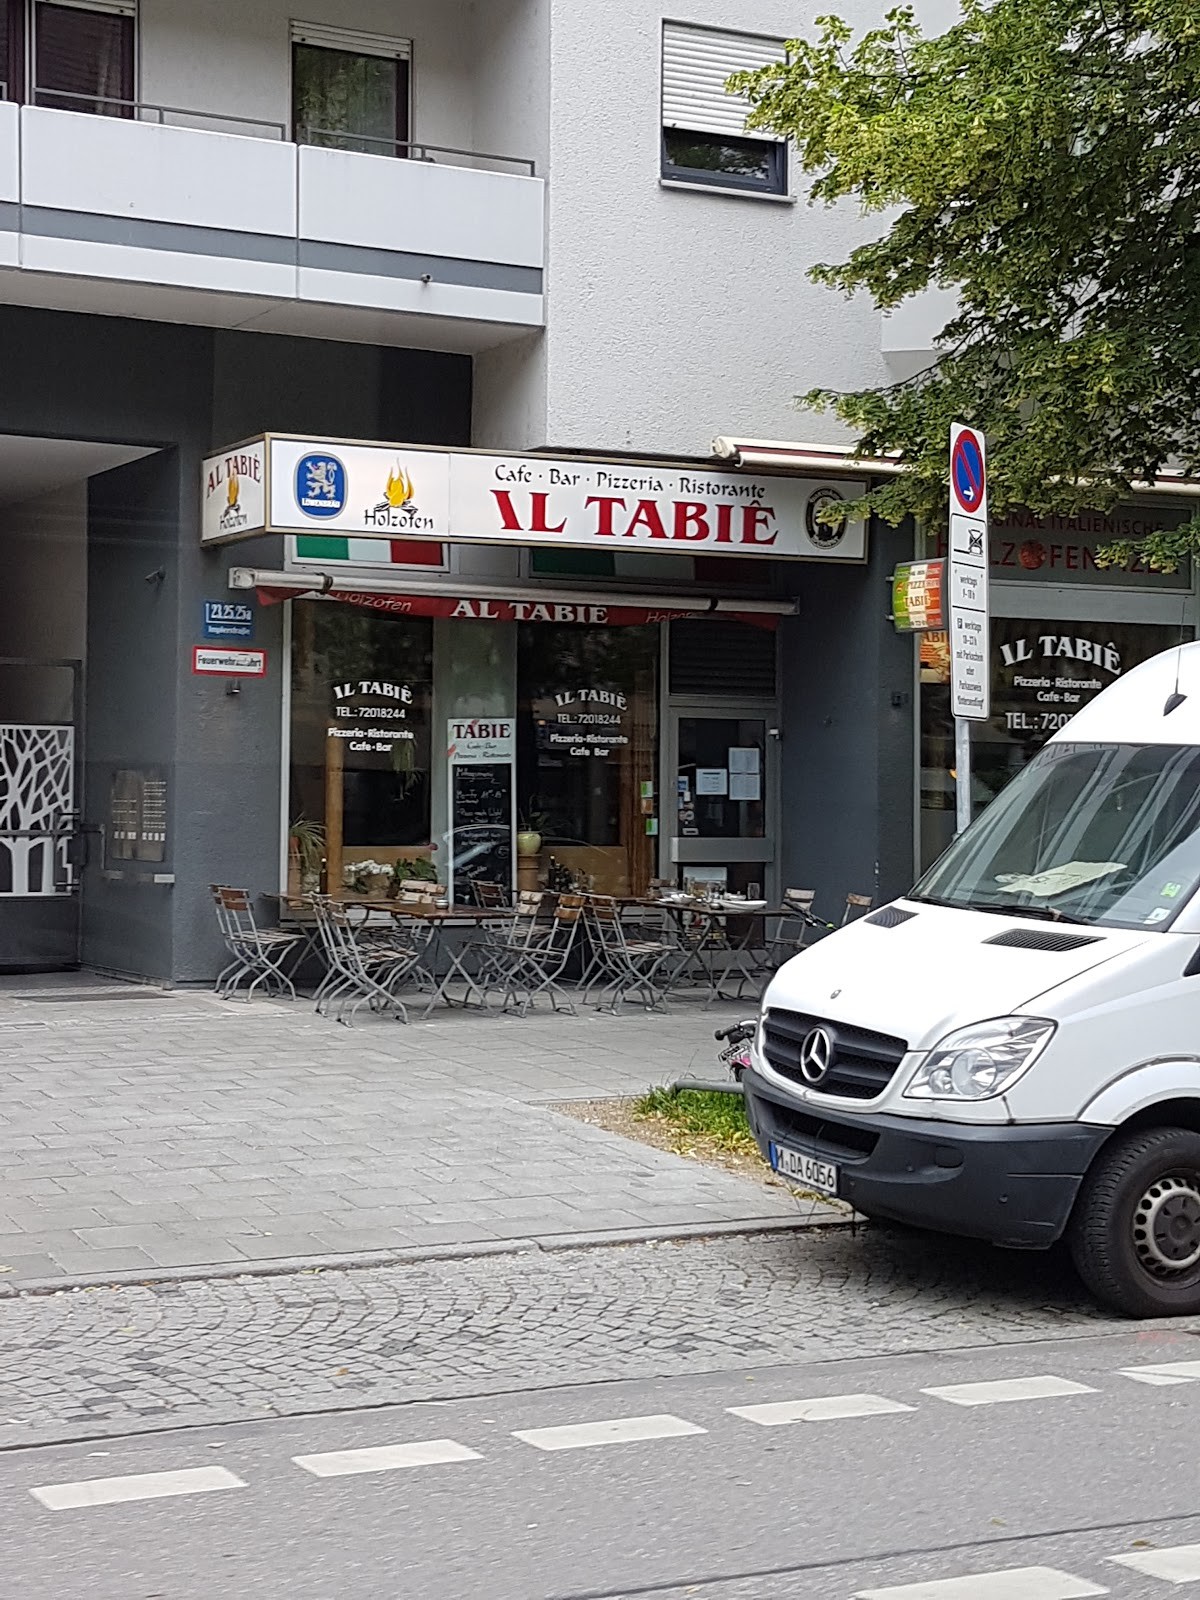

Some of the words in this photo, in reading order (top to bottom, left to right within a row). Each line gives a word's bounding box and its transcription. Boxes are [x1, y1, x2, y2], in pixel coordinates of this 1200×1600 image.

[495, 464, 532, 483] Cafe
[549, 468, 580, 487] Bar
[597, 471, 664, 492] Pizzeria
[679, 477, 765, 499] Ristorante
[365, 509, 434, 529] Holzofen
[450, 599, 499, 619] AL
